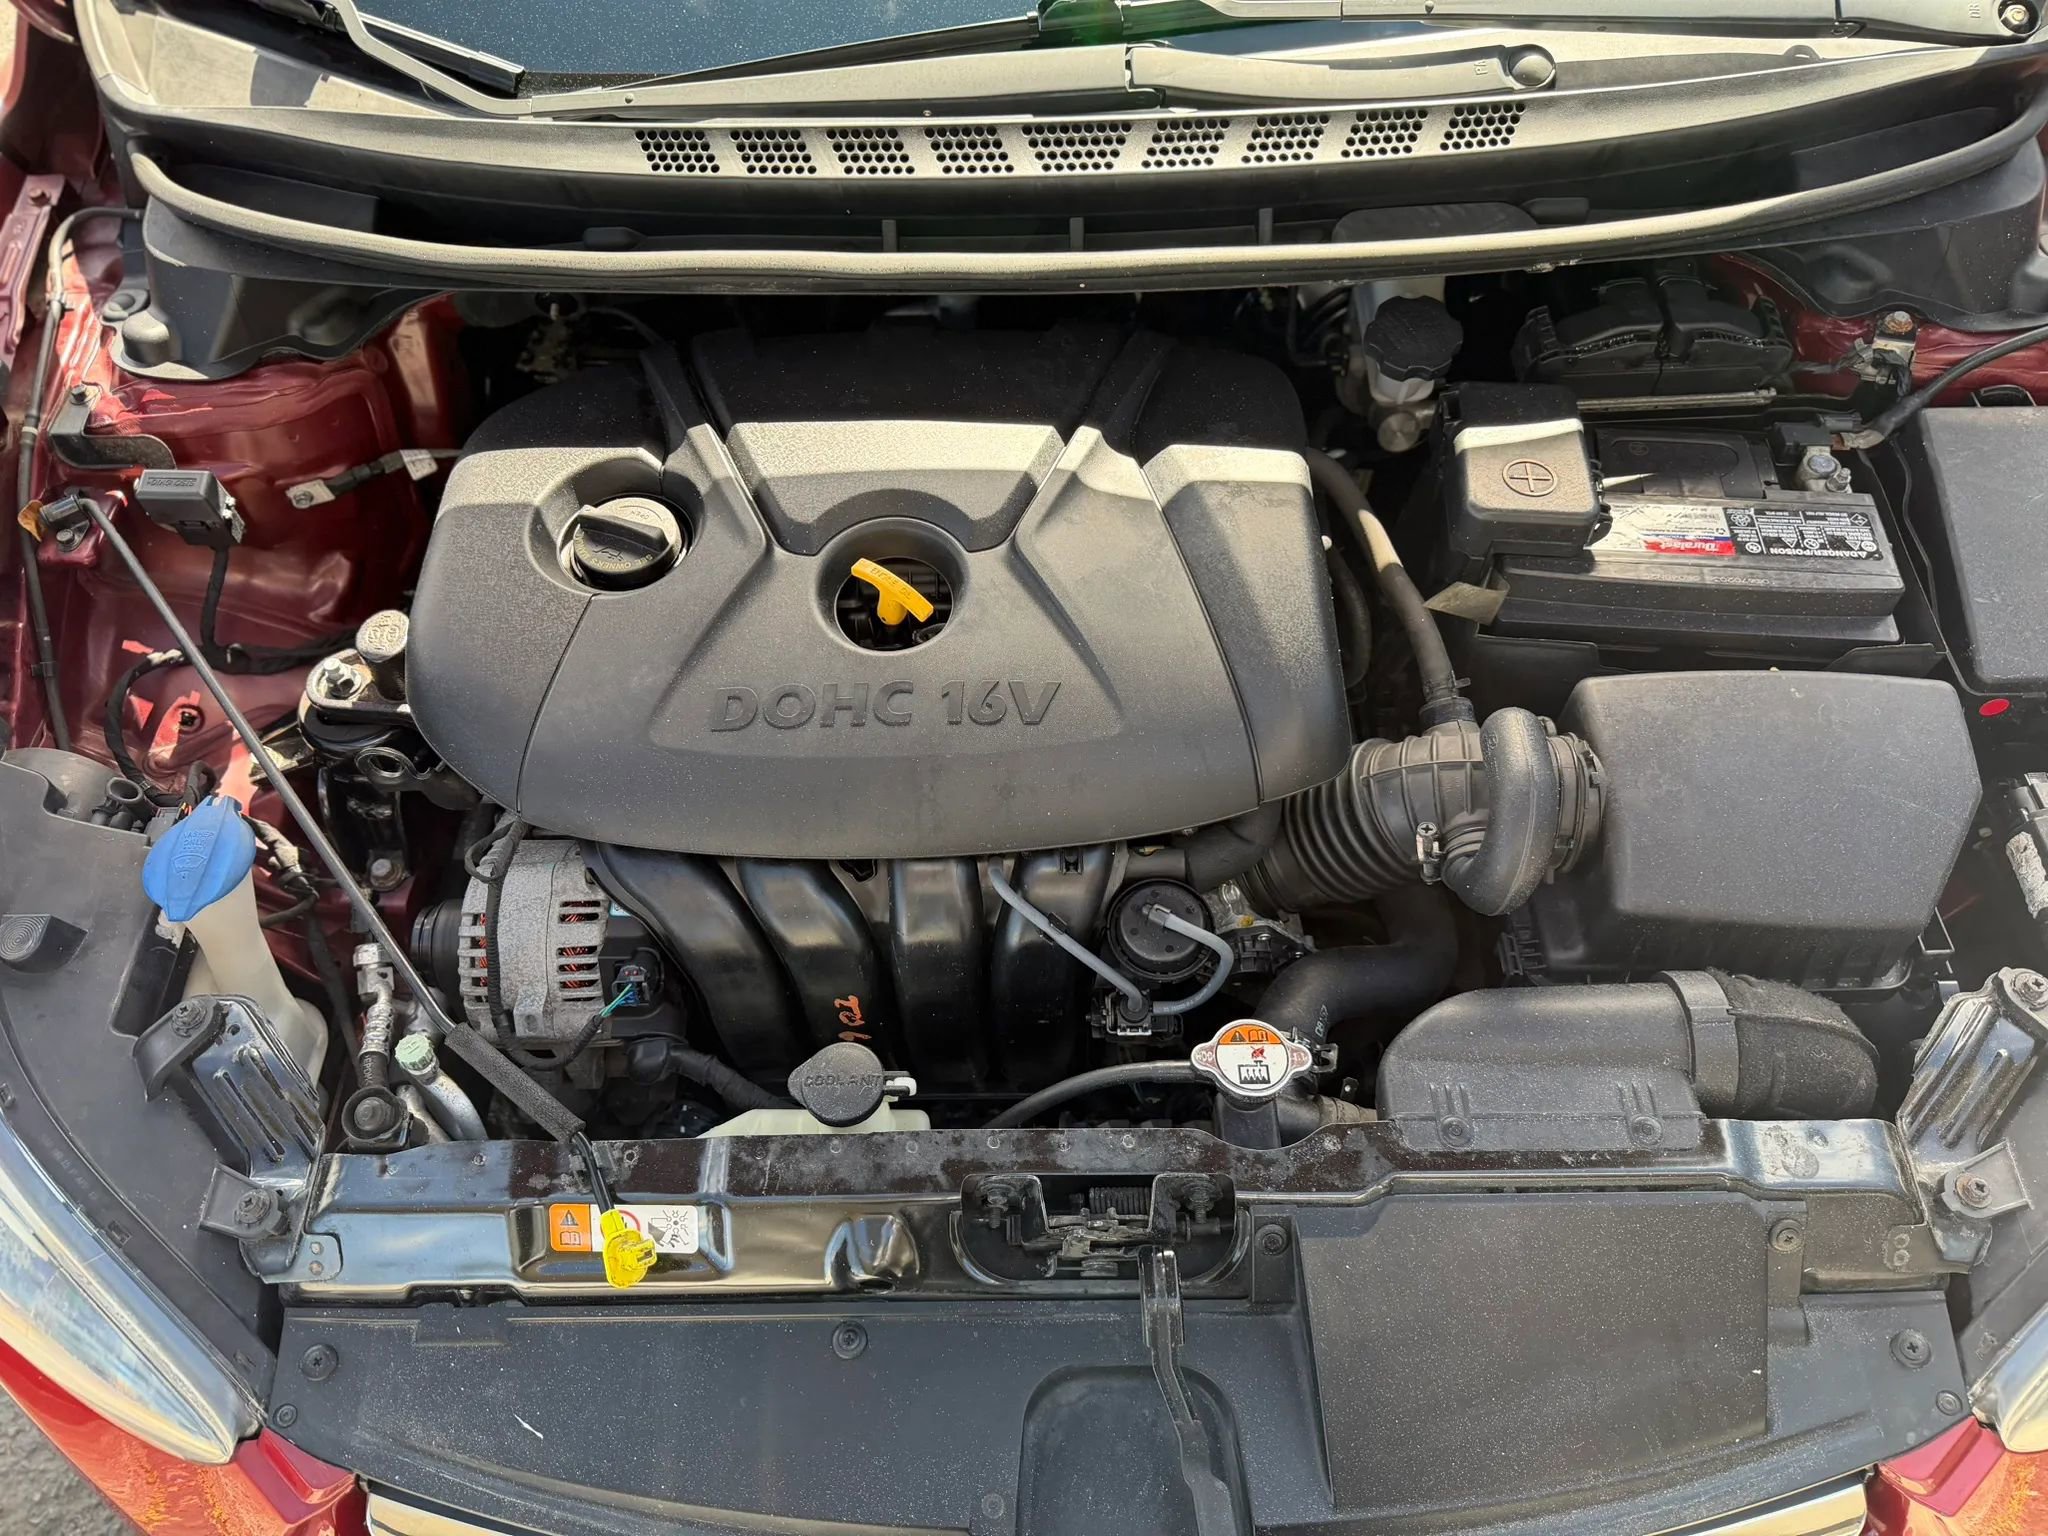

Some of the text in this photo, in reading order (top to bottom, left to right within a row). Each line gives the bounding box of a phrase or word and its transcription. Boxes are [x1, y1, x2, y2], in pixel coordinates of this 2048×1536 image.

[1661, 540, 1719, 552] Duralast
[1769, 547, 1858, 558] DANGER/POISON
[711, 679, 1062, 732] DOHC 16V
[803, 1073, 882, 1088] COOLANT
